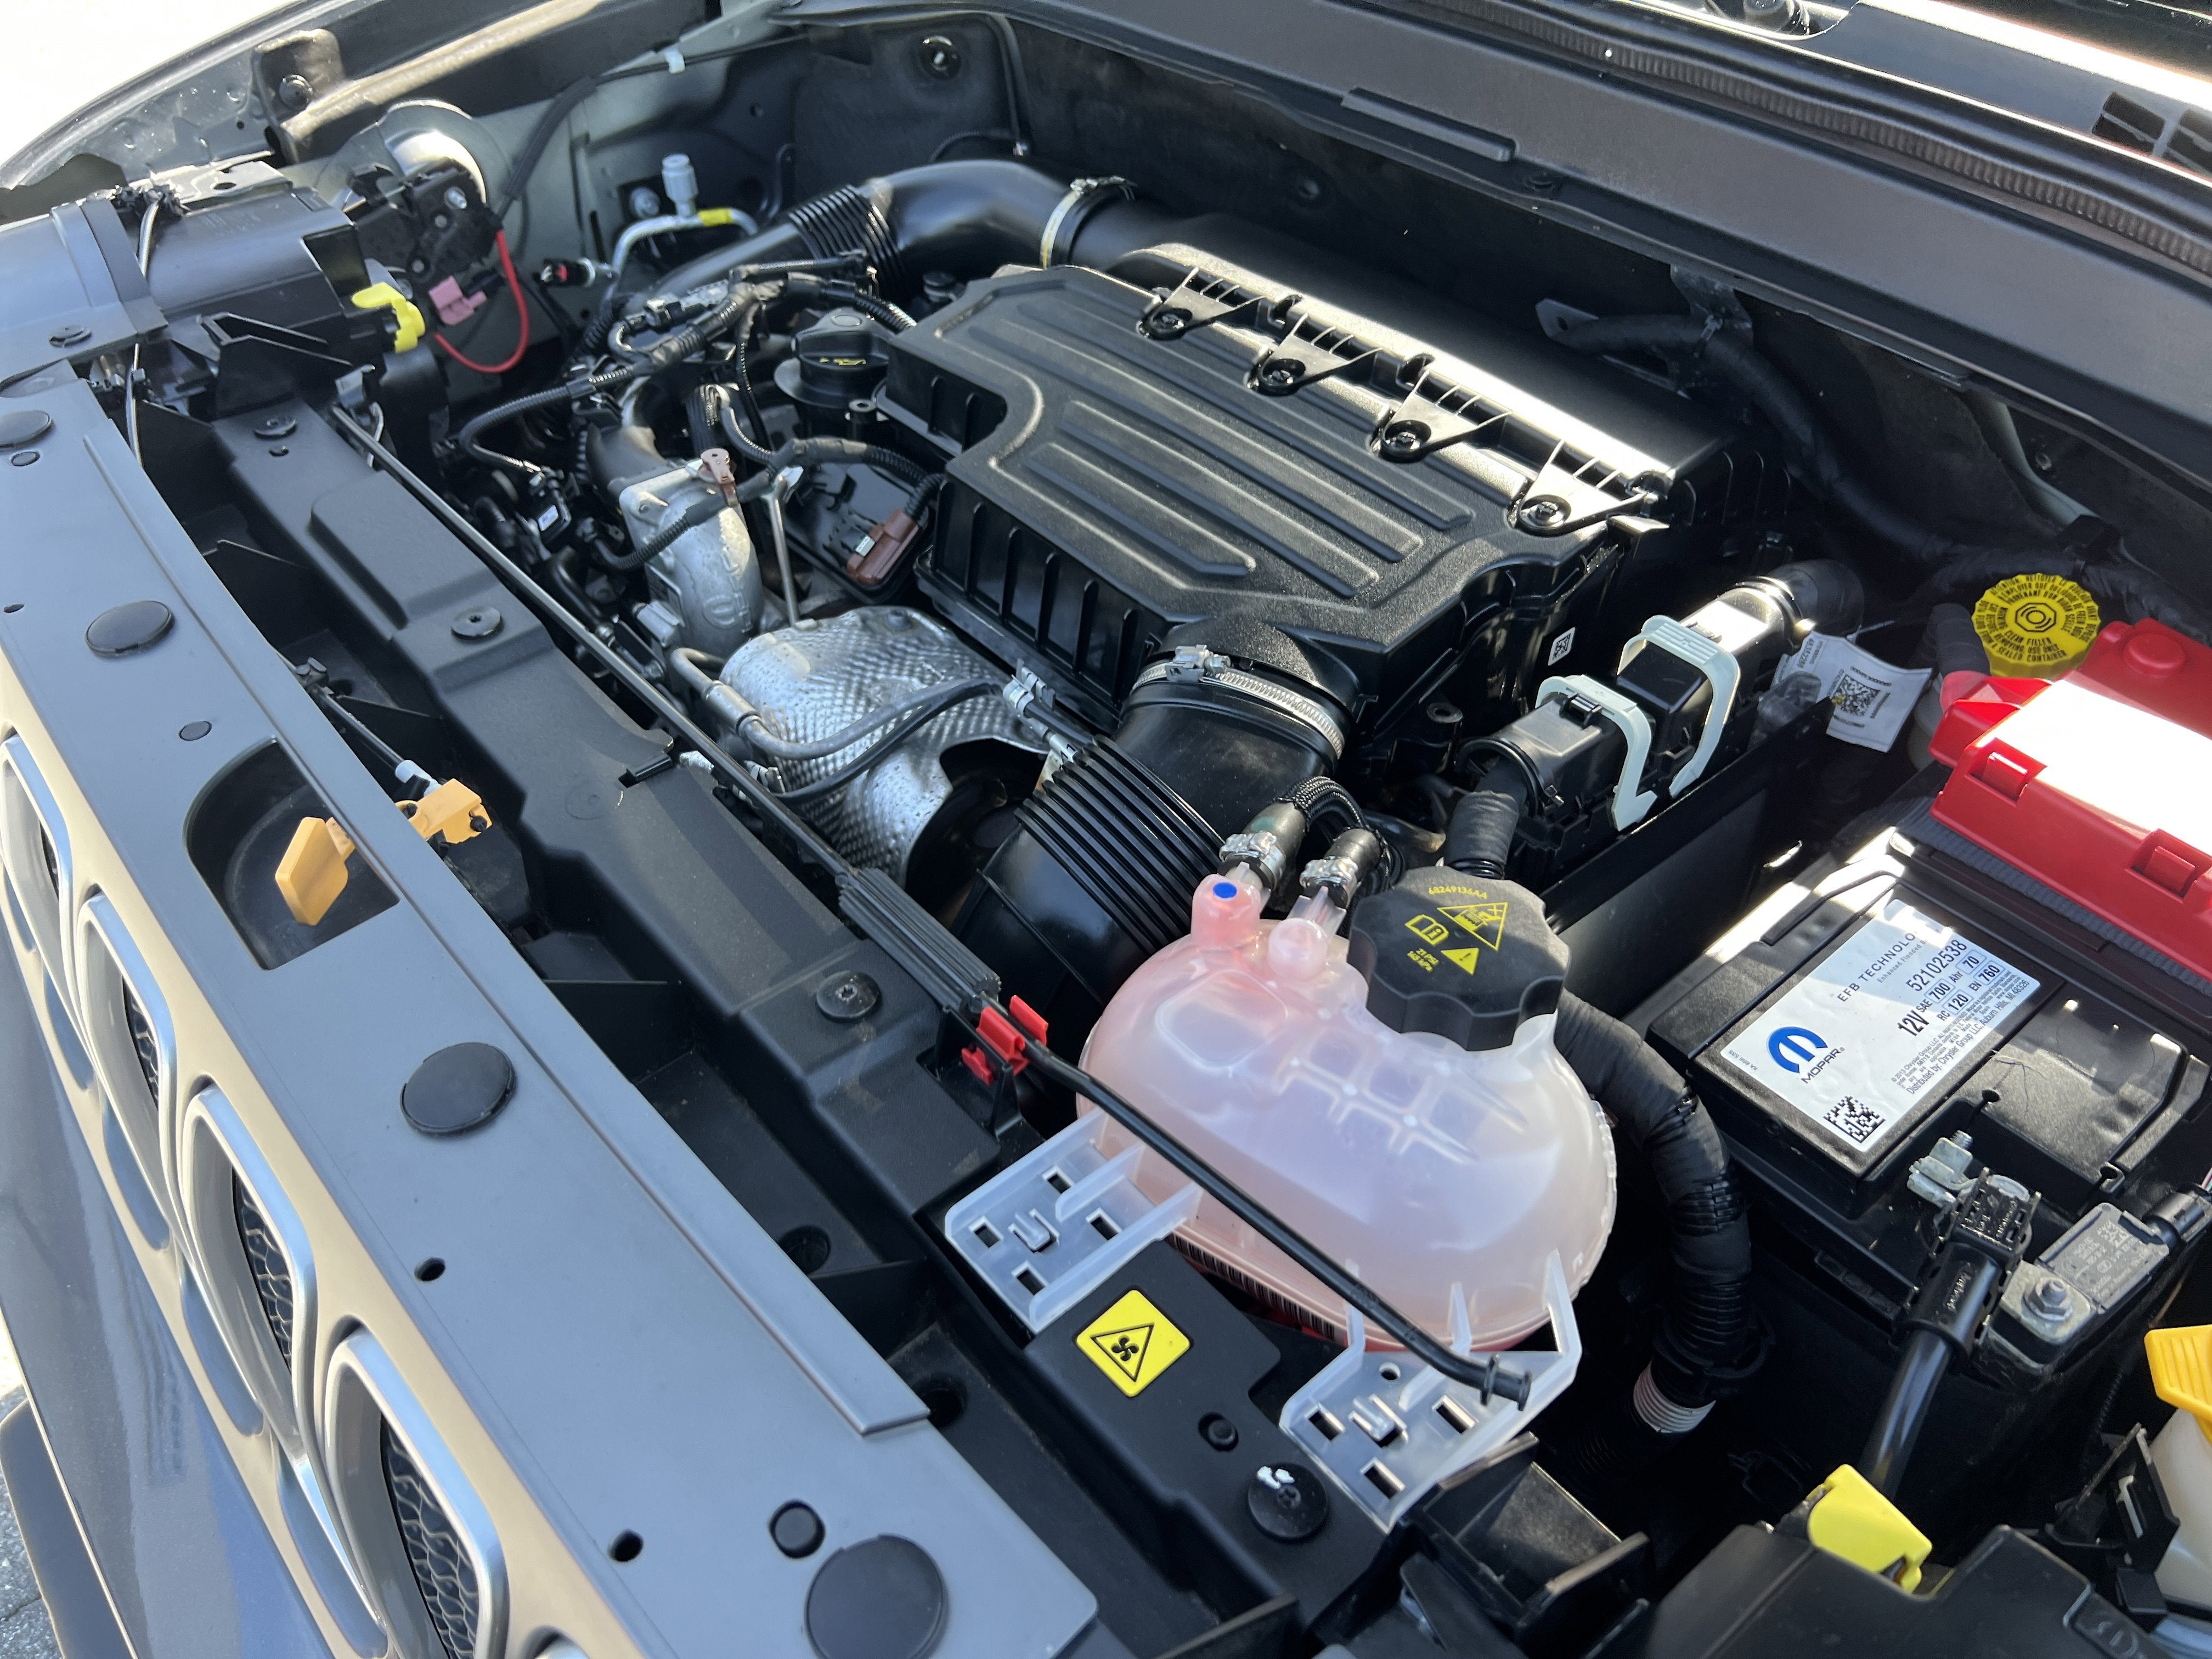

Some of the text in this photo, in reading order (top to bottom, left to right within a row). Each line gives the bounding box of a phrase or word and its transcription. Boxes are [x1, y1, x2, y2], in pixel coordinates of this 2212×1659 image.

[2027, 637, 2052, 646] FILLER
[2027, 650, 2067, 662] CONTAINER
[1836, 982, 1860, 1002] EFB
[1858, 931, 1917, 983] TECHNOLO
[1876, 944, 1922, 983] Enhanced Flooded
[1905, 939, 1968, 992] 52102538
[1897, 956, 1979, 1037] 12V SAE 700 Ahr 70
[1936, 964, 2000, 1021] RC 120 EN 760
[2005, 992, 2016, 1000] MI
[2010, 979, 2030, 995] 48326
[1978, 1008, 1999, 1025] Auburn
[1955, 1032, 1975, 1048] Group
[1903, 1055, 1921, 1070] Chrysler
[1917, 1045, 1932, 1057] Group
[1928, 1037, 1939, 1046] LLC
[1937, 1045, 1962, 1065] Chrysler
[1906, 1069, 1934, 1094] Distributed
